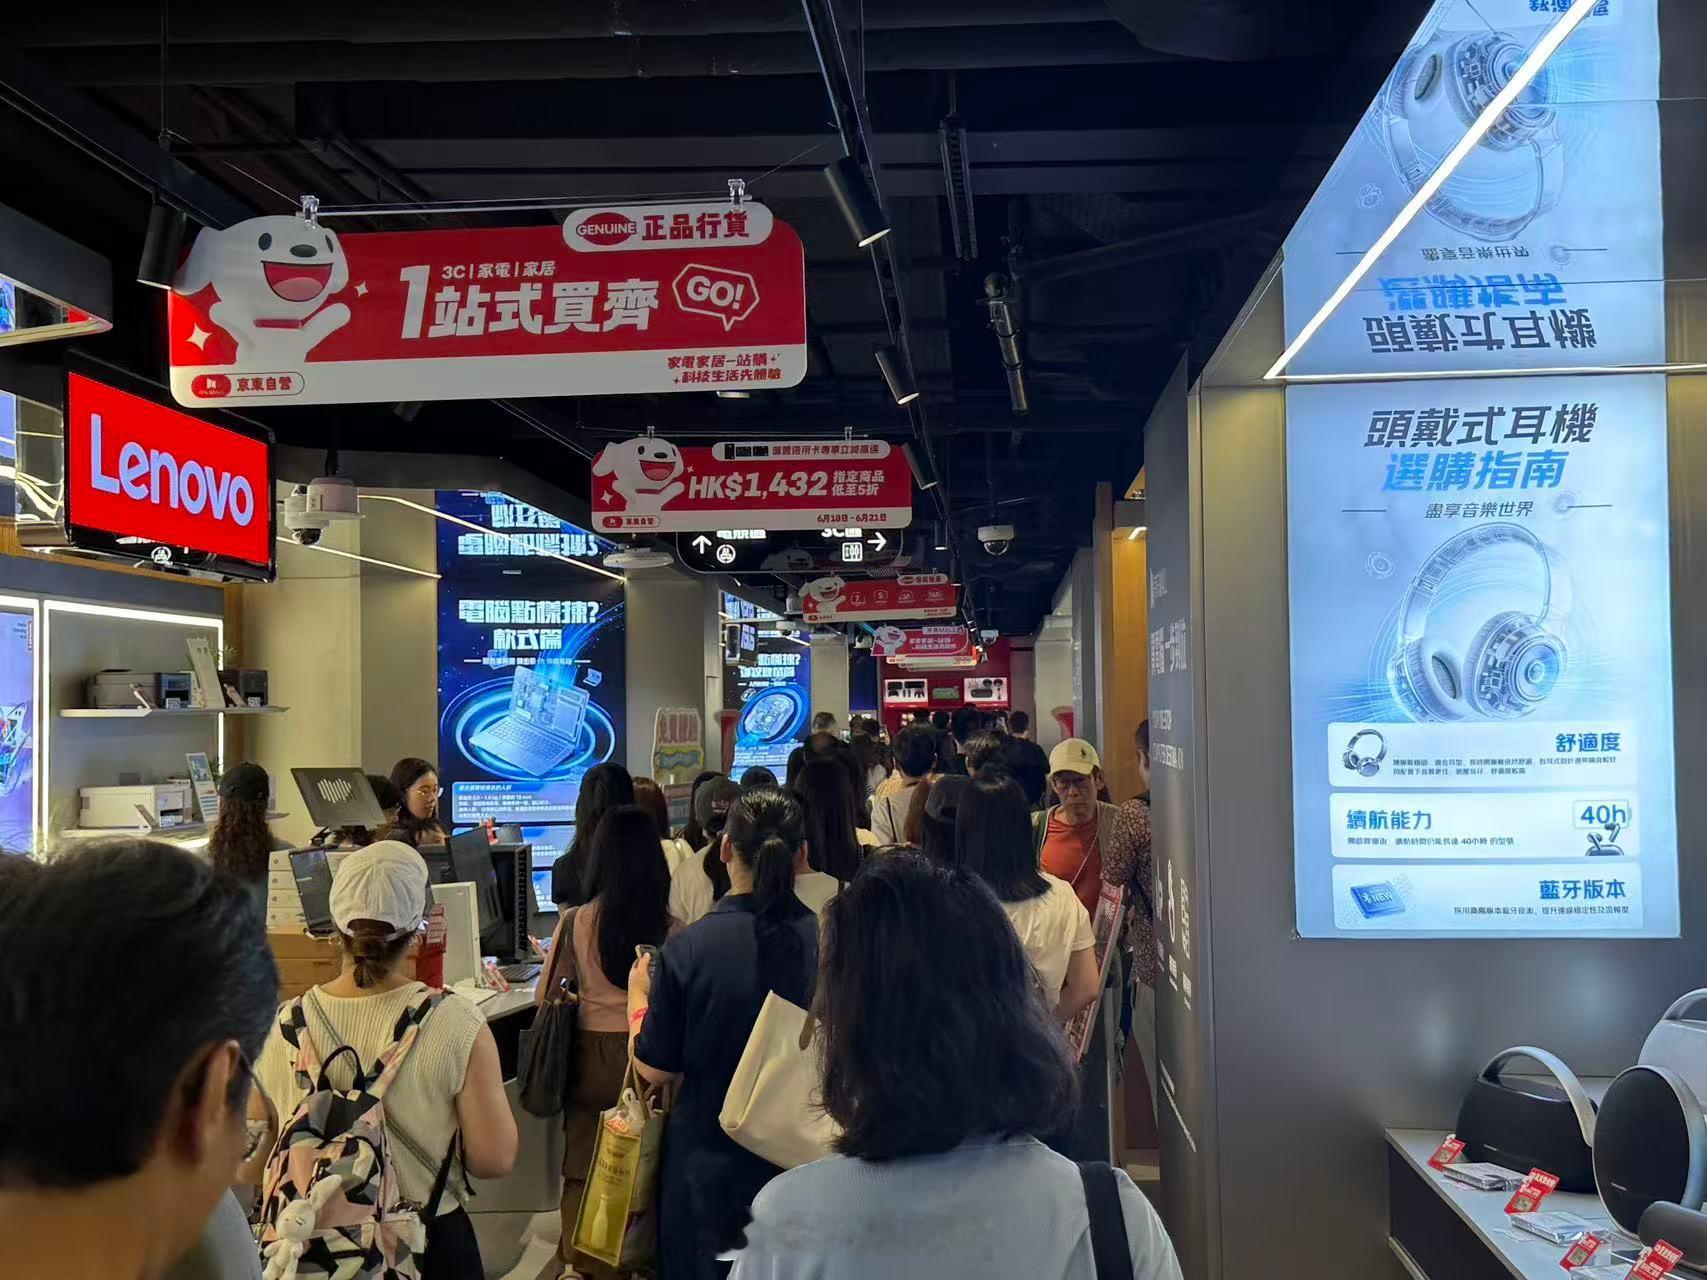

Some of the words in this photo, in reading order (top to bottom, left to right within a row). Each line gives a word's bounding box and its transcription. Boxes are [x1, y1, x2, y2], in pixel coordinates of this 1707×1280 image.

[576, 222, 637, 237] GENUINE
[641, 213, 750, 241] 正品行貨
[686, 274, 744, 309] GO!
[237, 376, 292, 391] 京東自營
[1364, 403, 1599, 448] 頭戴式耳機
[91, 413, 254, 527] Lenovo
[833, 470, 885, 483] 指定商品
[1381, 450, 1569, 491] 選購指南
[688, 471, 828, 500] HK$1,432
[832, 484, 879, 497] 低至5折
[1424, 501, 1534, 519] 盡享音樂世界
[1555, 732, 1621, 753] 舒適度
[1347, 809, 1432, 831] 續航能力
[1580, 806, 1627, 824] 40h
[1539, 879, 1626, 900] 藍牙版本
